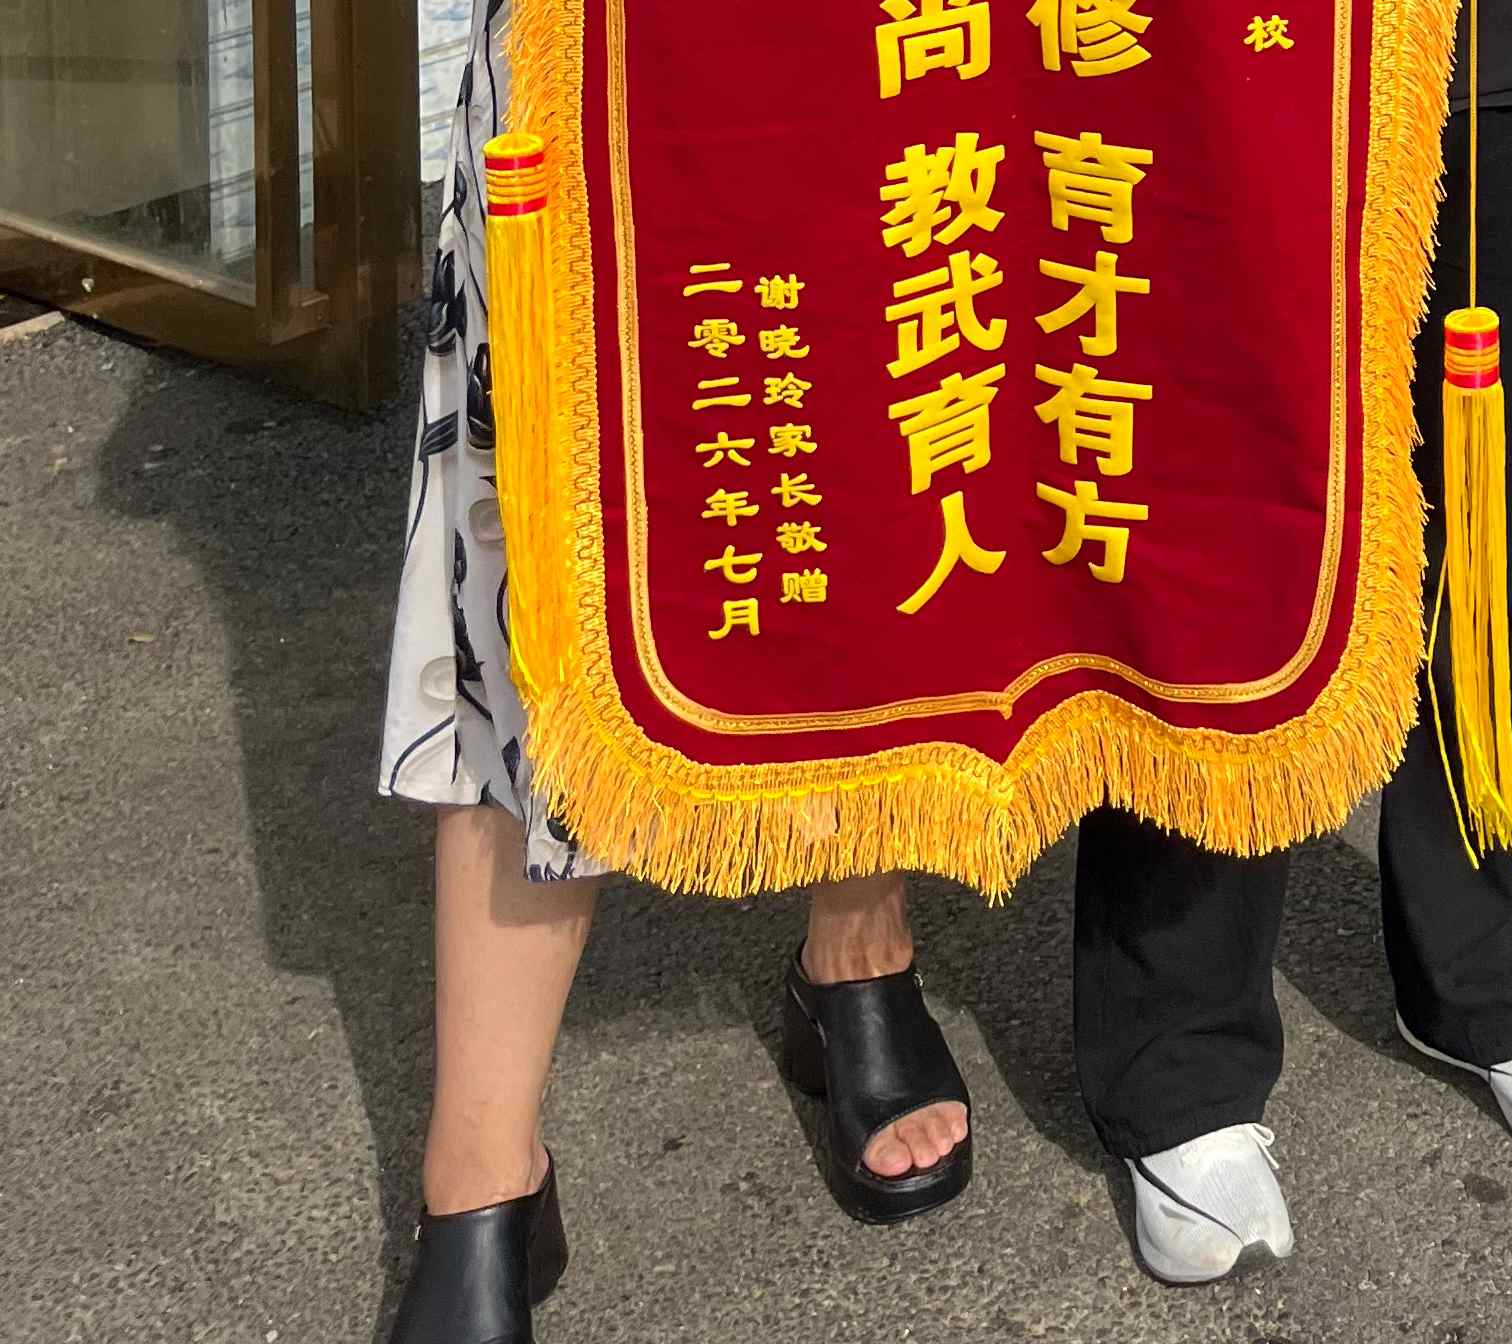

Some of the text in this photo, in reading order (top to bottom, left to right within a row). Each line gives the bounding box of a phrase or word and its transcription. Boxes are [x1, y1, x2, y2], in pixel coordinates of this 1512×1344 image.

[682, 262, 762, 640] 二零二六年七月
[754, 273, 829, 605] 谢晓玲家长敬赠
[879, 131, 1008, 617] 教武育人
[1033, 129, 1154, 584] 育才有方
